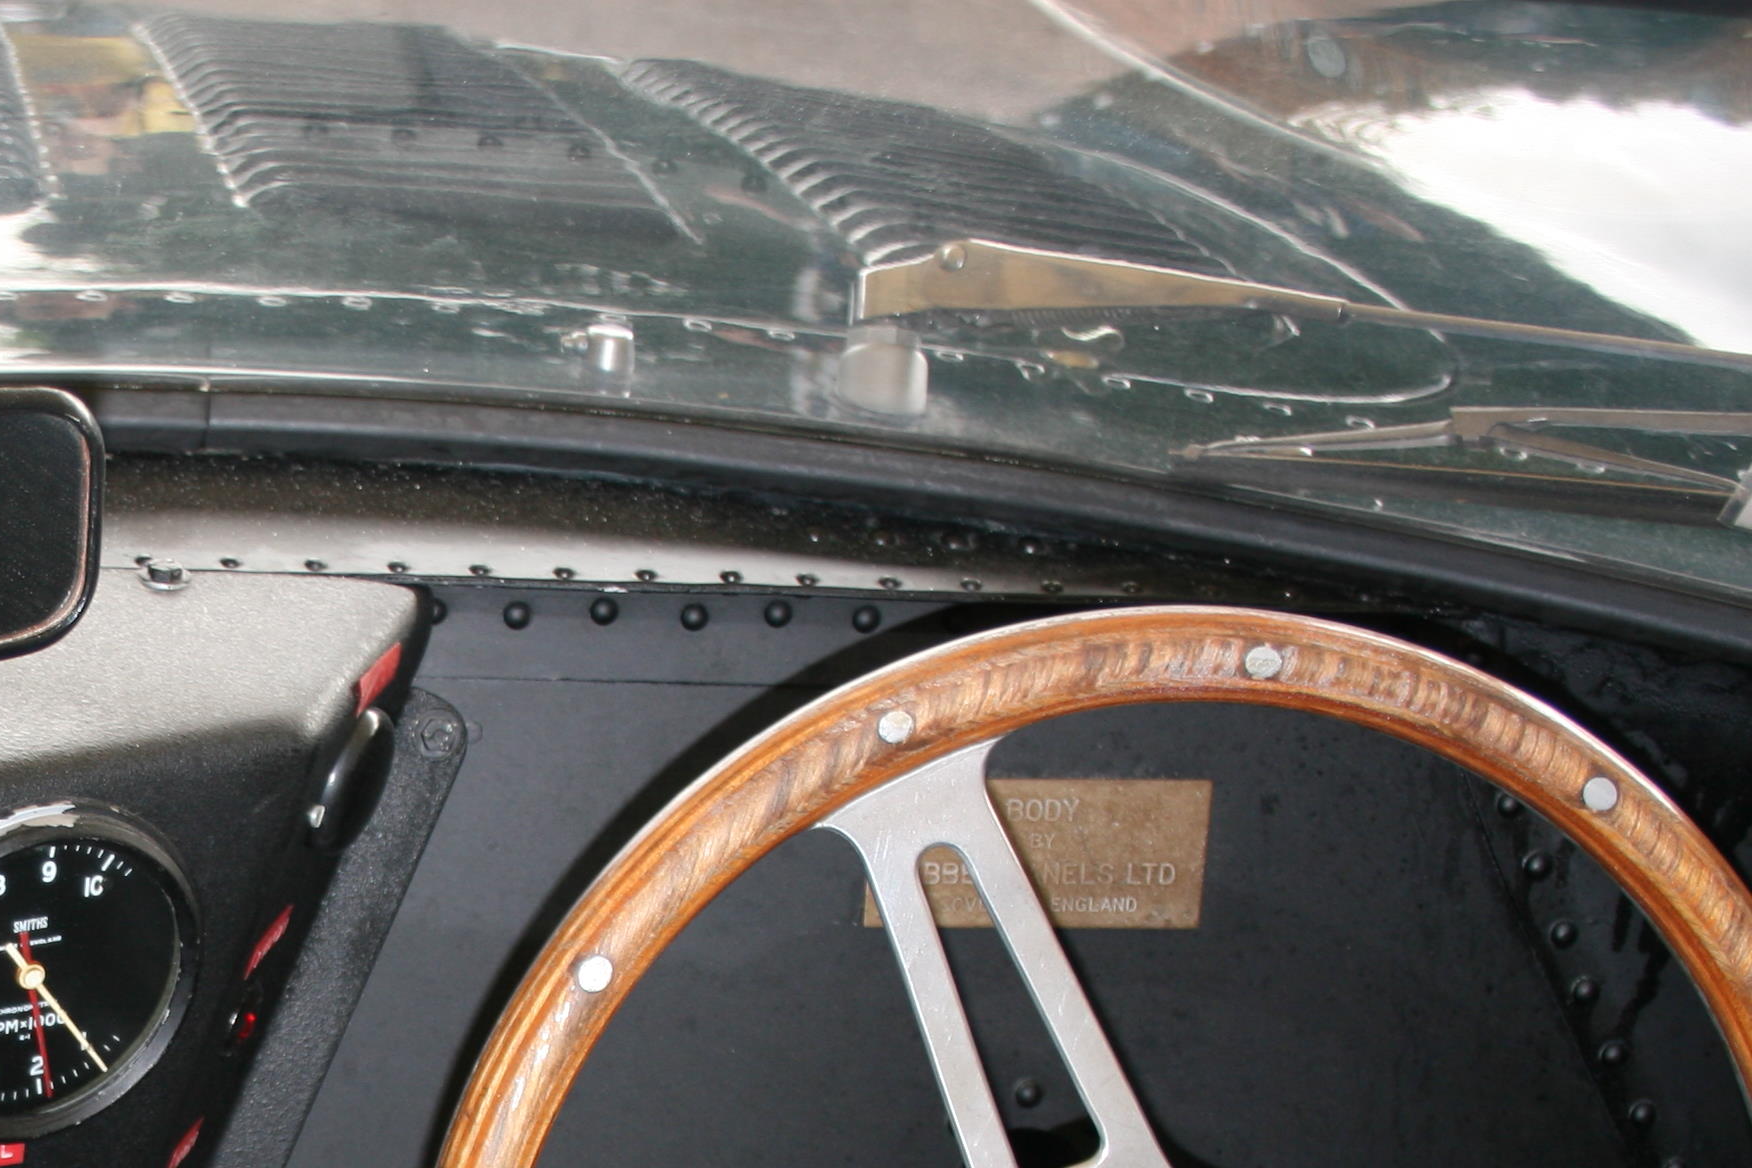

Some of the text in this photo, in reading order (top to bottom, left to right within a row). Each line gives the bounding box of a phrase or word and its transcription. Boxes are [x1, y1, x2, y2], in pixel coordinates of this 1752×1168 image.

[1005, 797, 1081, 823] BODY
[1030, 832, 1057, 850] BY
[41, 862, 57, 883] 9
[1126, 861, 1177, 886] LTD
[1050, 896, 1139, 914] ENGLAND
[13, 917, 48, 934] SMITHS
[30, 1056, 44, 1076] 2
